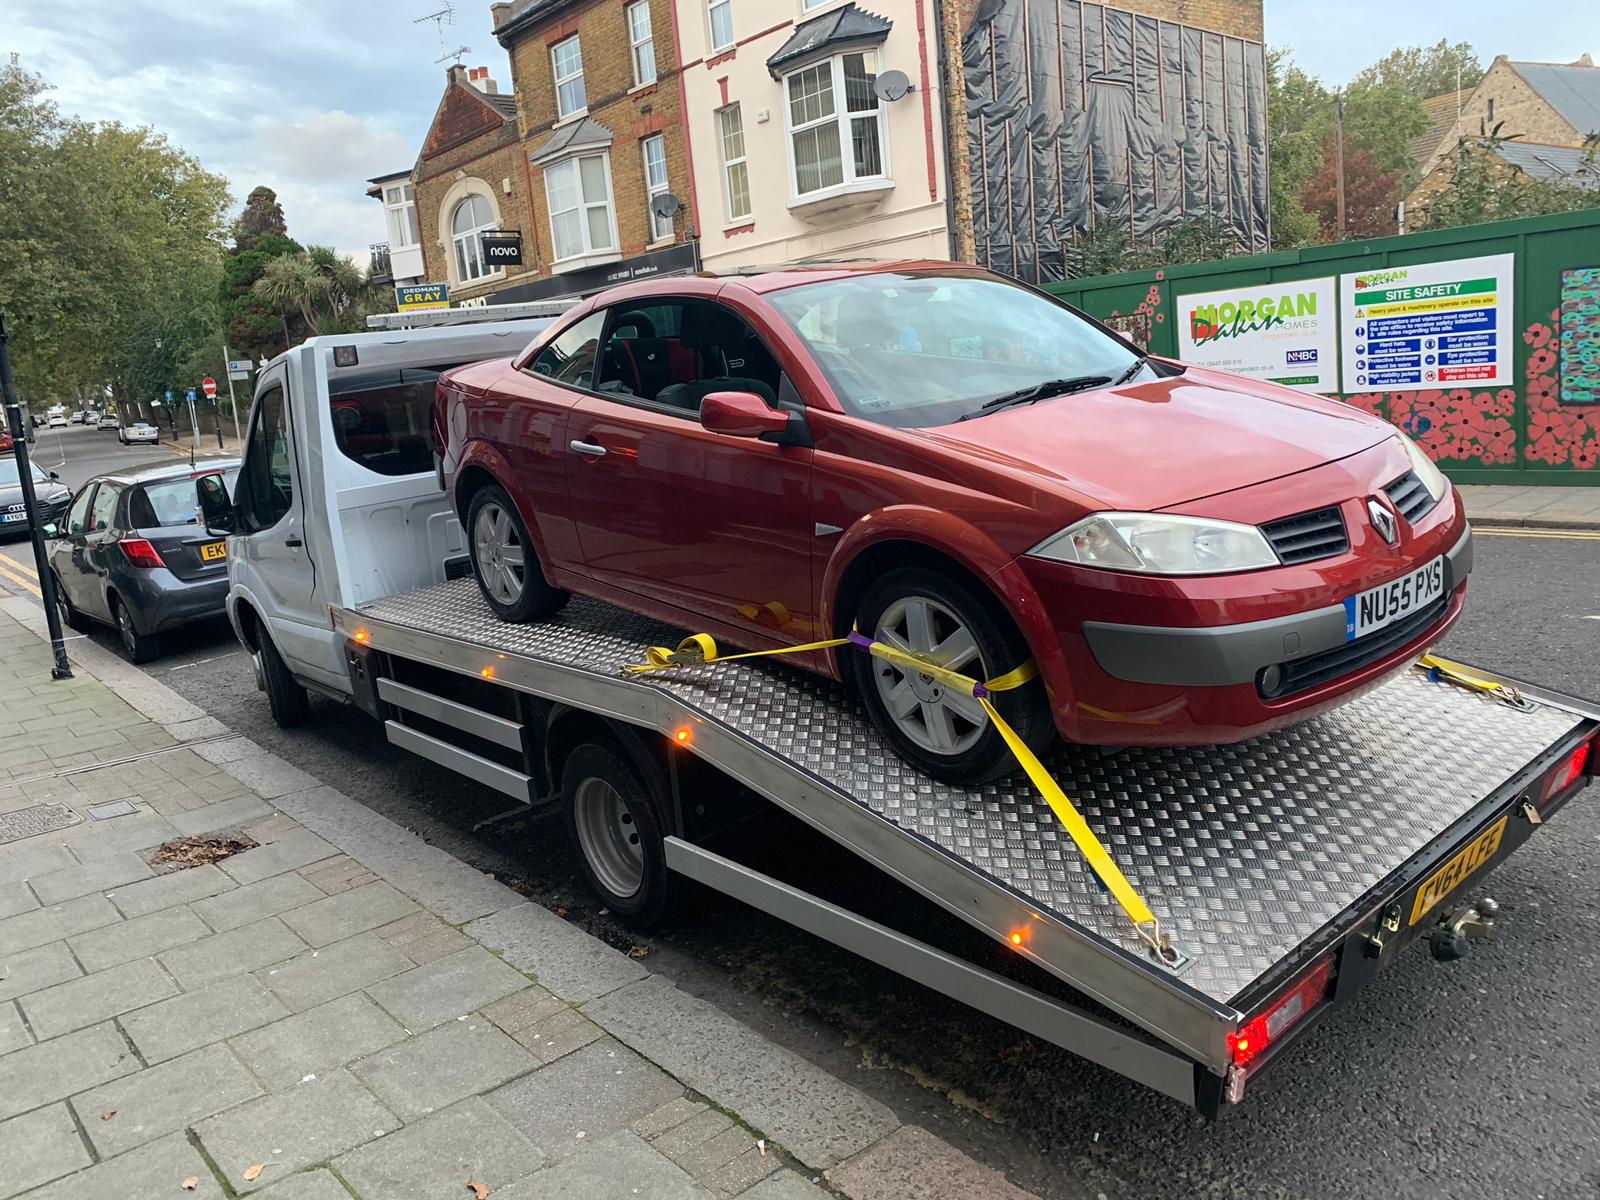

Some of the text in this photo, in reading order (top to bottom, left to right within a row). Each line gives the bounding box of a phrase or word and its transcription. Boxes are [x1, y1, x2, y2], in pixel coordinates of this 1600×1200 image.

[490, 247, 517, 256] novo
[1357, 270, 1408, 281] MORGAN
[403, 286, 440, 294] DEDMAN
[1386, 283, 1462, 301] SITE SAFETY
[404, 292, 440, 302] GRAY
[1196, 292, 1317, 325] MORGAN
[1191, 309, 1284, 346] Dakin
[1275, 319, 1318, 330] HOMES
[1287, 351, 1317, 361] NHBC
[207, 544, 226, 557] EK
[1360, 560, 1440, 628] NU55 PXS
[1419, 827, 1500, 914] FV64 LFE
